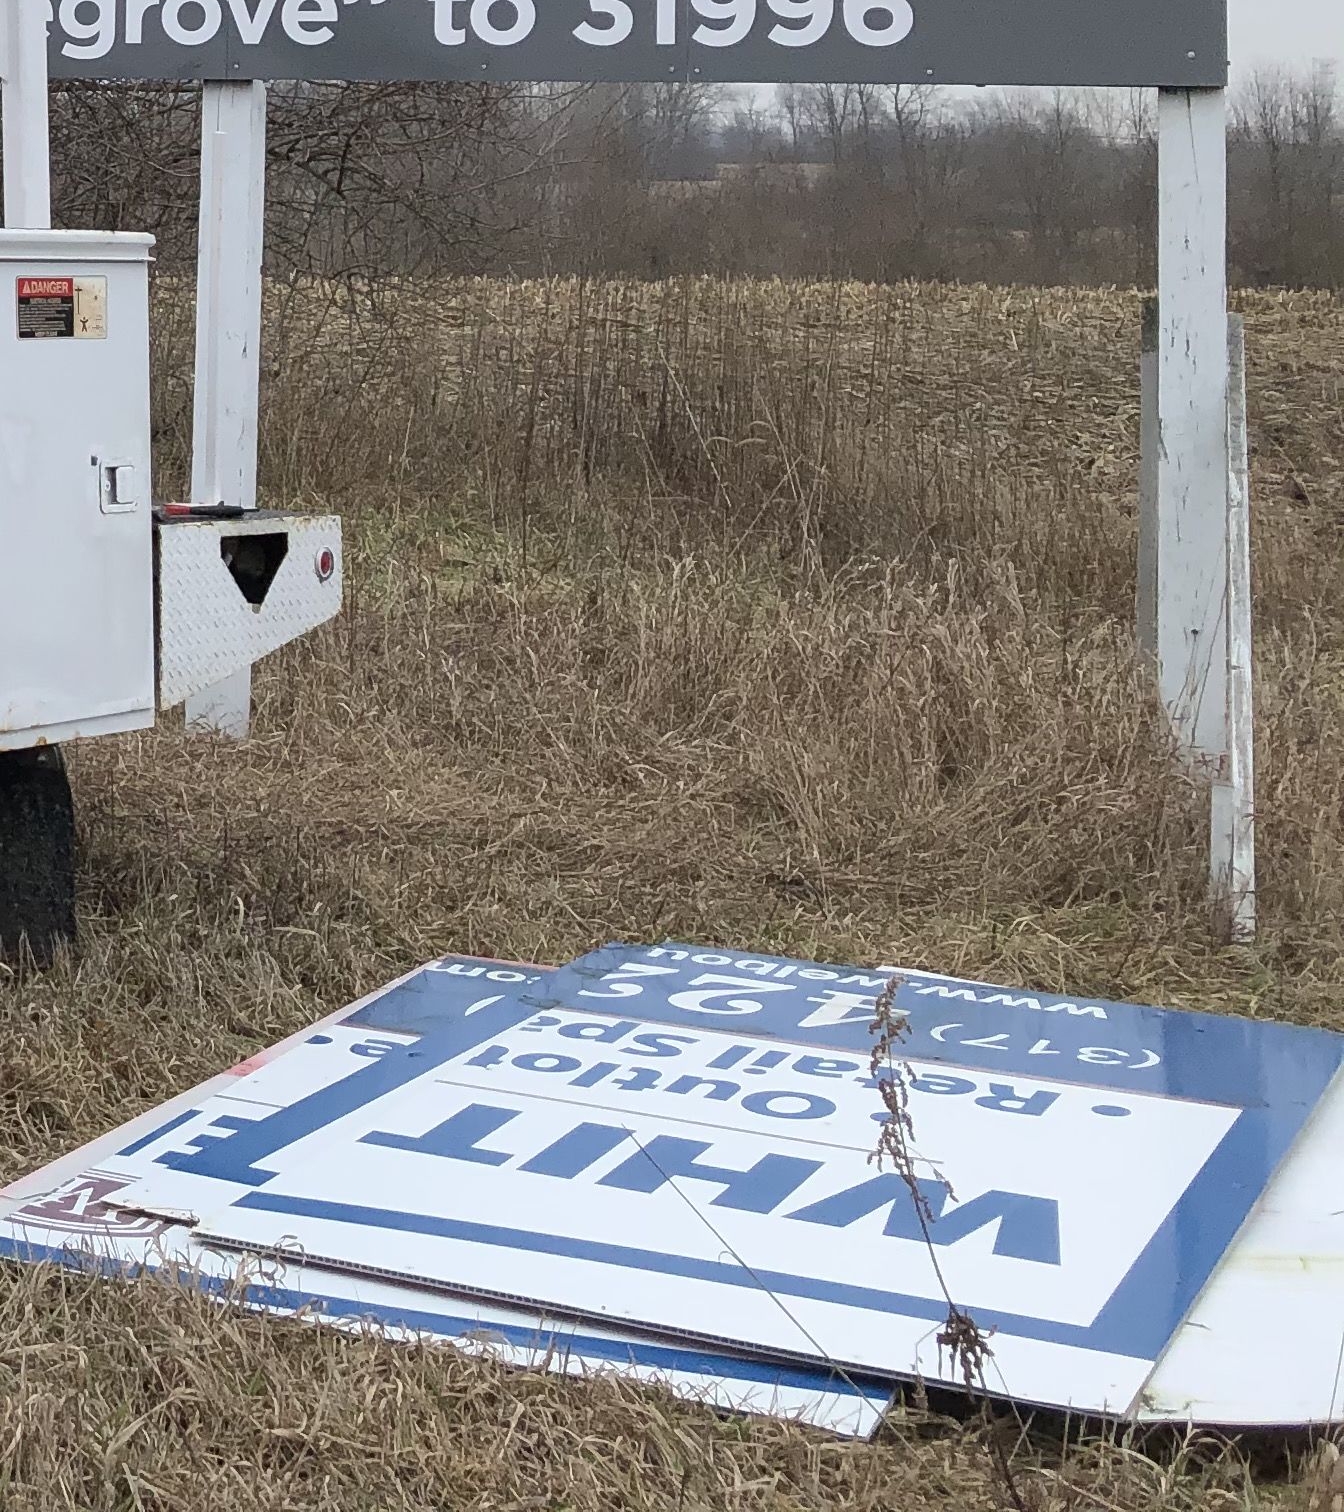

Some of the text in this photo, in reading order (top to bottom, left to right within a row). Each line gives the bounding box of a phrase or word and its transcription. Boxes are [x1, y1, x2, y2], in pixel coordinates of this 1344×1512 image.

[31, 280, 69, 294] DANGER
[929, 1022, 1162, 1069] (317)
[706, 1044, 1062, 1117] Retail
[357, 1103, 1061, 1266] WHIT
